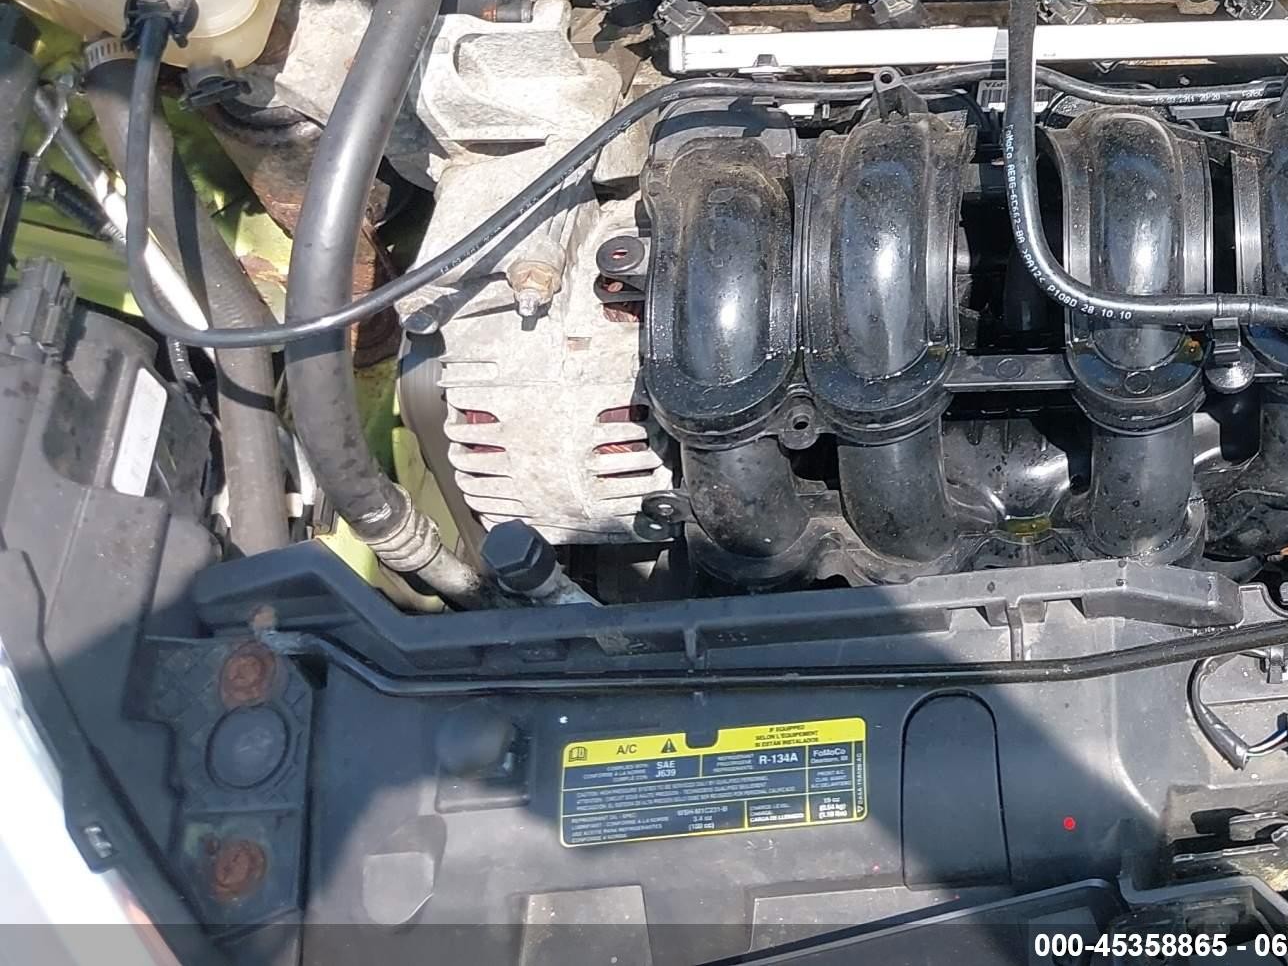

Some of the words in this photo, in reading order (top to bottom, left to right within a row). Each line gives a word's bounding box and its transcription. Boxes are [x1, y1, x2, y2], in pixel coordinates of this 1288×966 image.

[615, 744, 638, 755] A/C
[813, 748, 846, 757] FoMoCo
[758, 752, 799, 765] R-134A
[656, 761, 676, 770] SAE
[655, 768, 676, 778] J639
